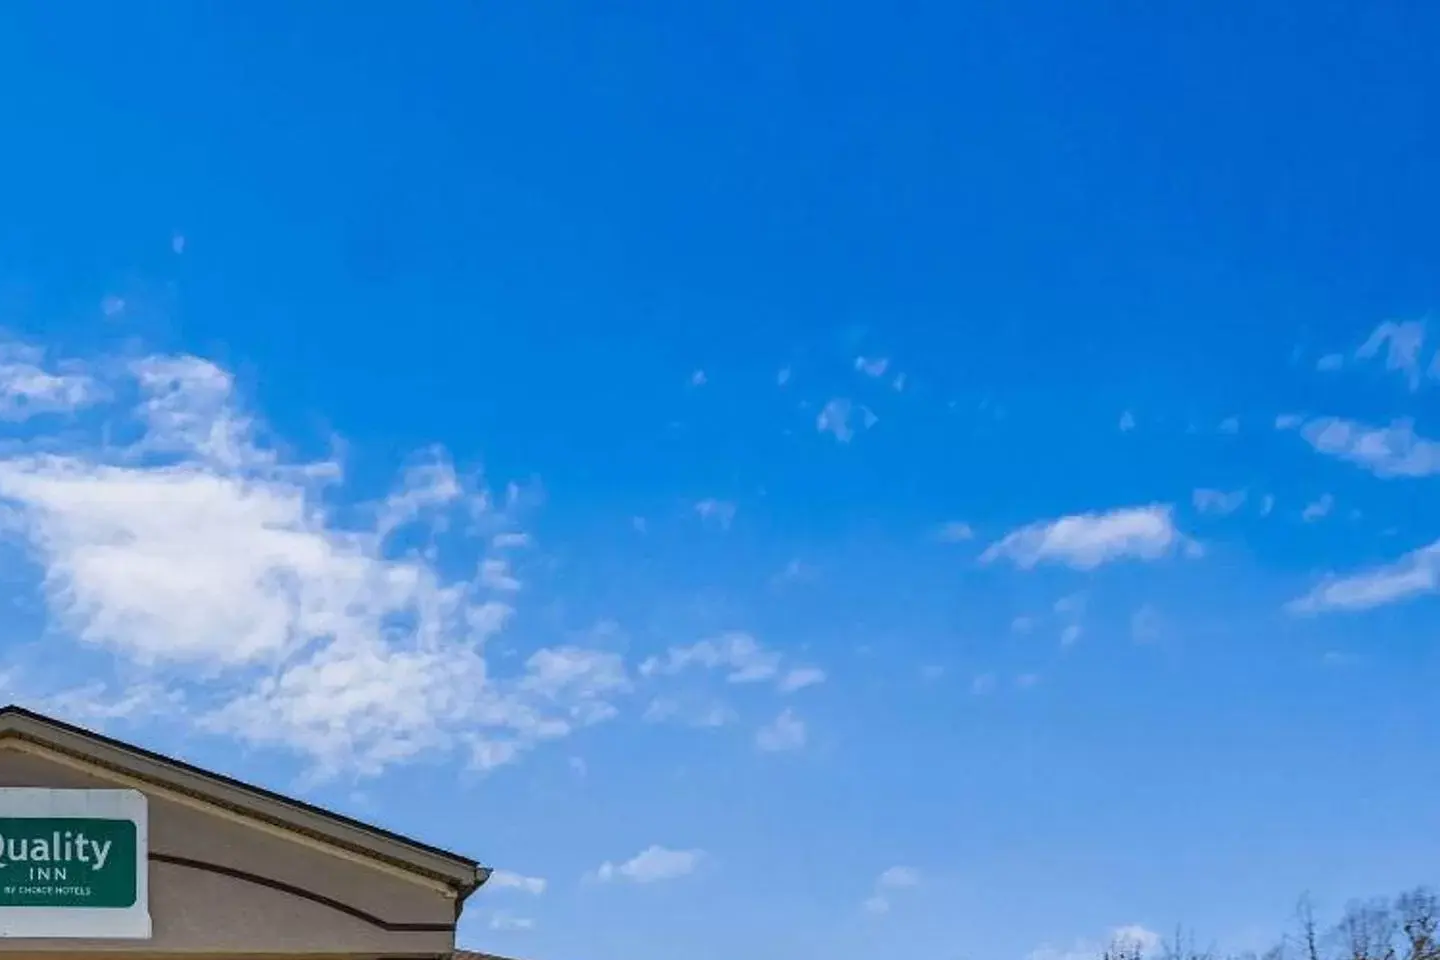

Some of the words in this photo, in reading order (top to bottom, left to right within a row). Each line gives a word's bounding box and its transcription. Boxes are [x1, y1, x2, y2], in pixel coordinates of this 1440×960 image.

[29, 867, 67, 881] INN
[19, 886, 53, 896] CHOICE
[55, 886, 91, 896] HOTELS
